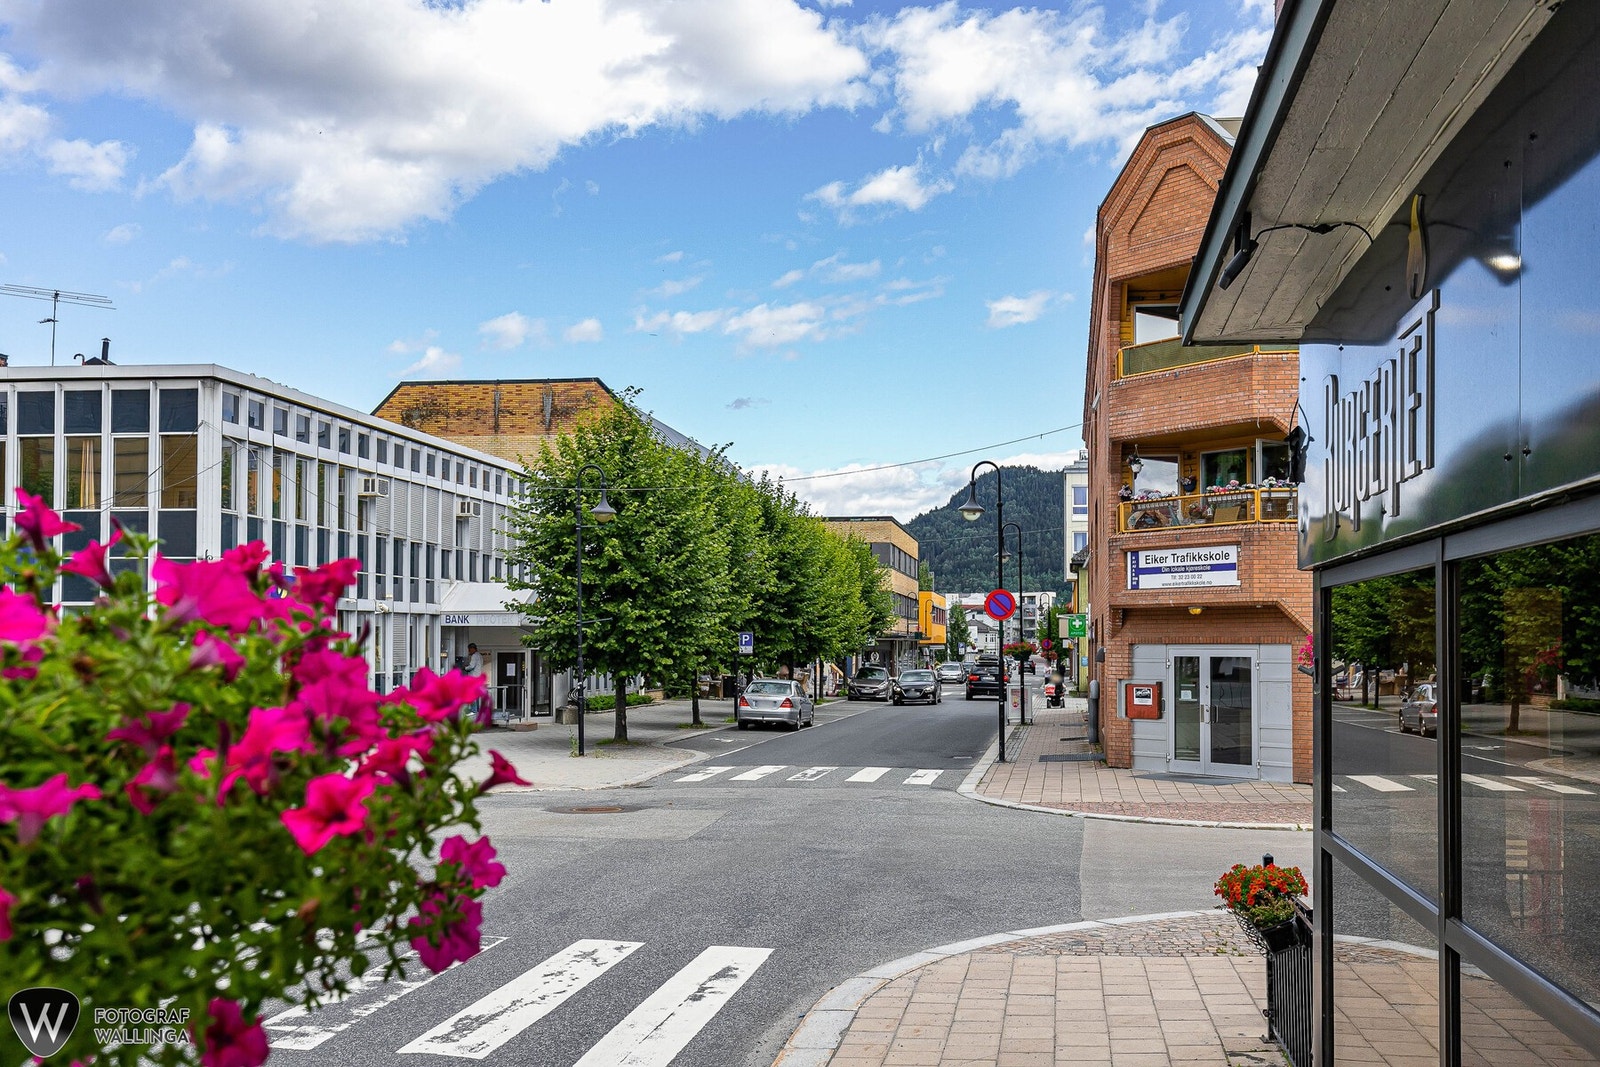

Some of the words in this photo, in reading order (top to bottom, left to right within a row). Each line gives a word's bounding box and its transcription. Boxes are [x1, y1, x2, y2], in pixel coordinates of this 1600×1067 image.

[1144, 554, 1169, 565] Eiker
[1171, 550, 1230, 563] Trafikkskole
[445, 614, 470, 624] BANK
[742, 634, 750, 645] P
